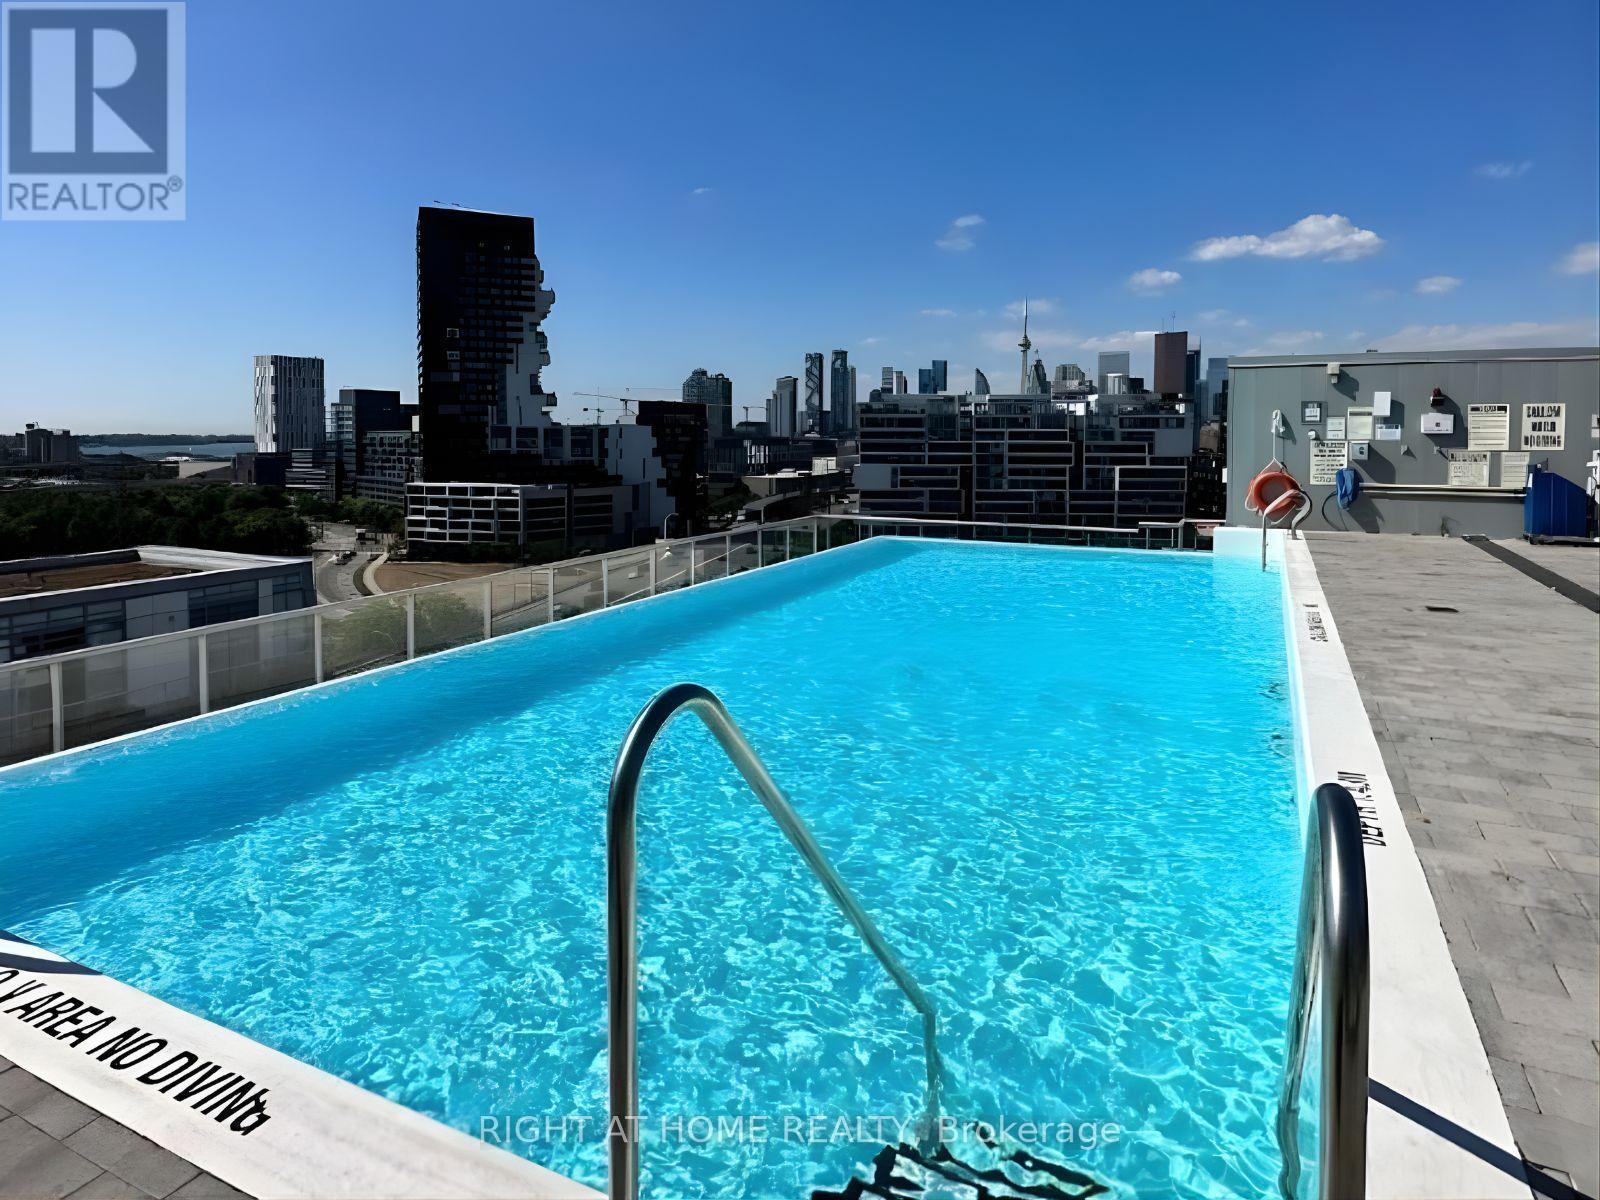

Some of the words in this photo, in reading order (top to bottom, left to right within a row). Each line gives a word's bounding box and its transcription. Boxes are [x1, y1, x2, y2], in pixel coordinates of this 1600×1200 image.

[3, 991, 117, 1049] AREA
[85, 1027, 168, 1071] NO
[136, 1050, 272, 1136] DIVING
